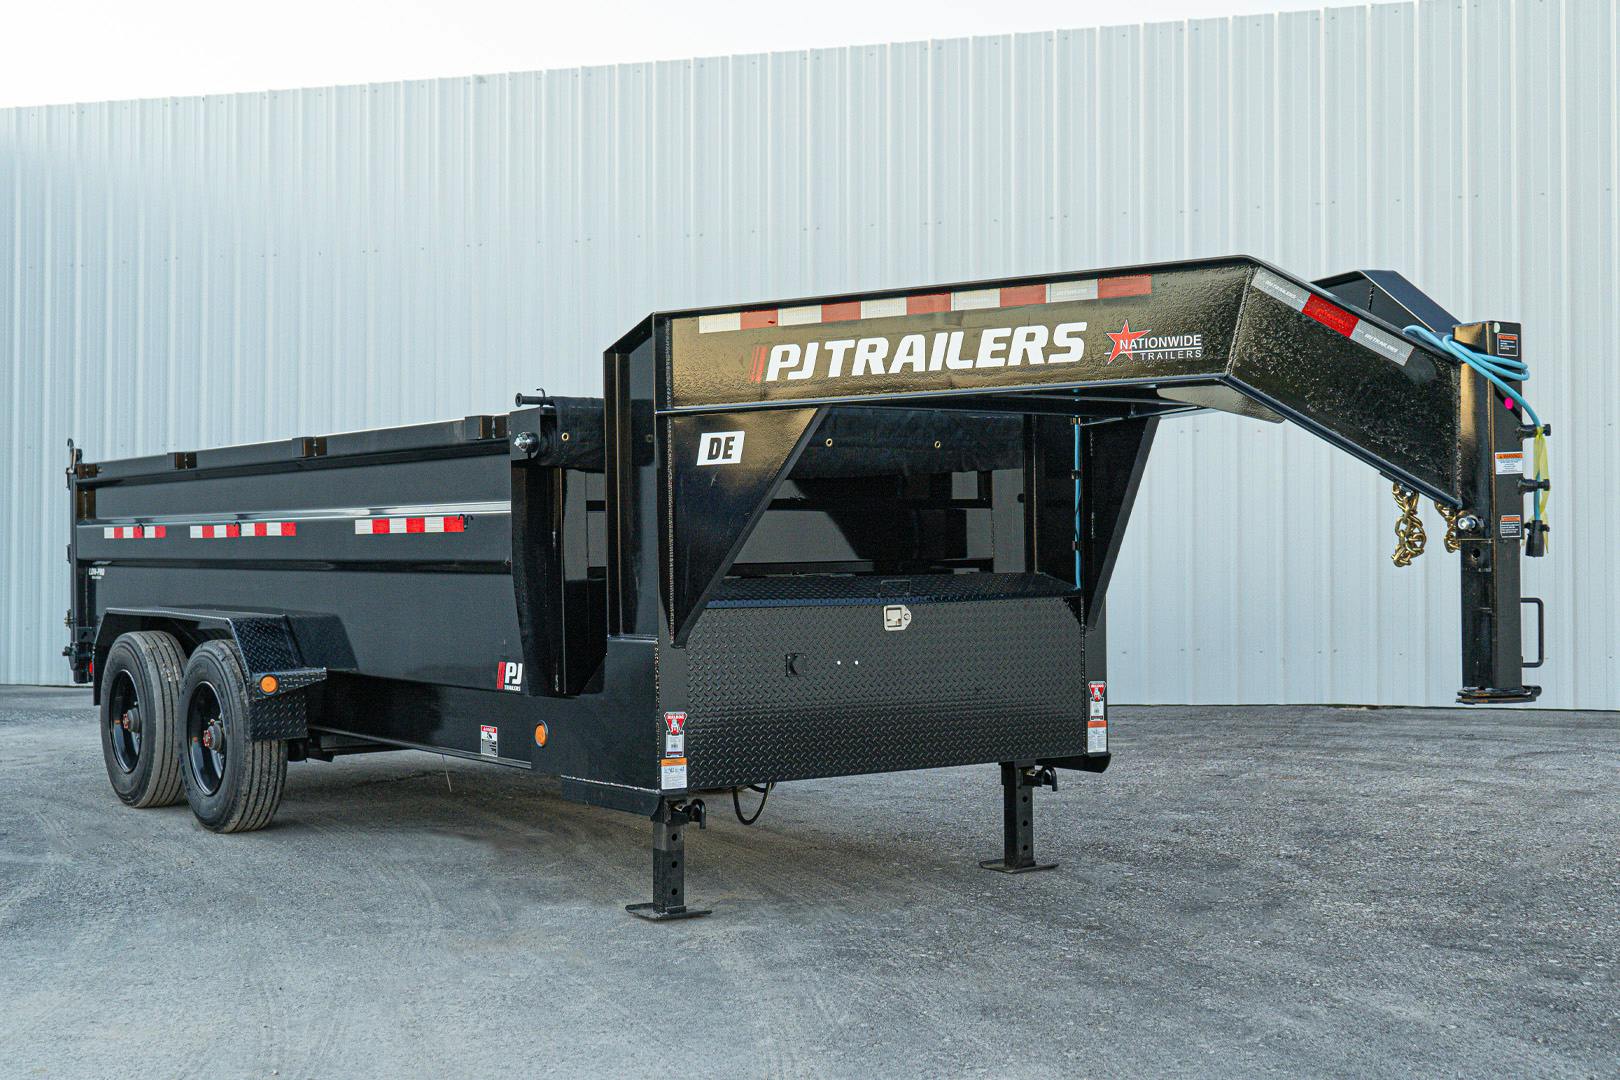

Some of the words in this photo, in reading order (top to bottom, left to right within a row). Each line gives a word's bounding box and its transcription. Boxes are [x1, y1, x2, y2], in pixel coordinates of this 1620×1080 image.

[765, 342, 819, 382] PJ
[824, 321, 1088, 378] TRAILERS
[1119, 334, 1202, 350] NATIONWIDE
[1139, 349, 1202, 361] TRAILERS
[707, 436, 736, 460] DE
[504, 661, 523, 685] PJ
